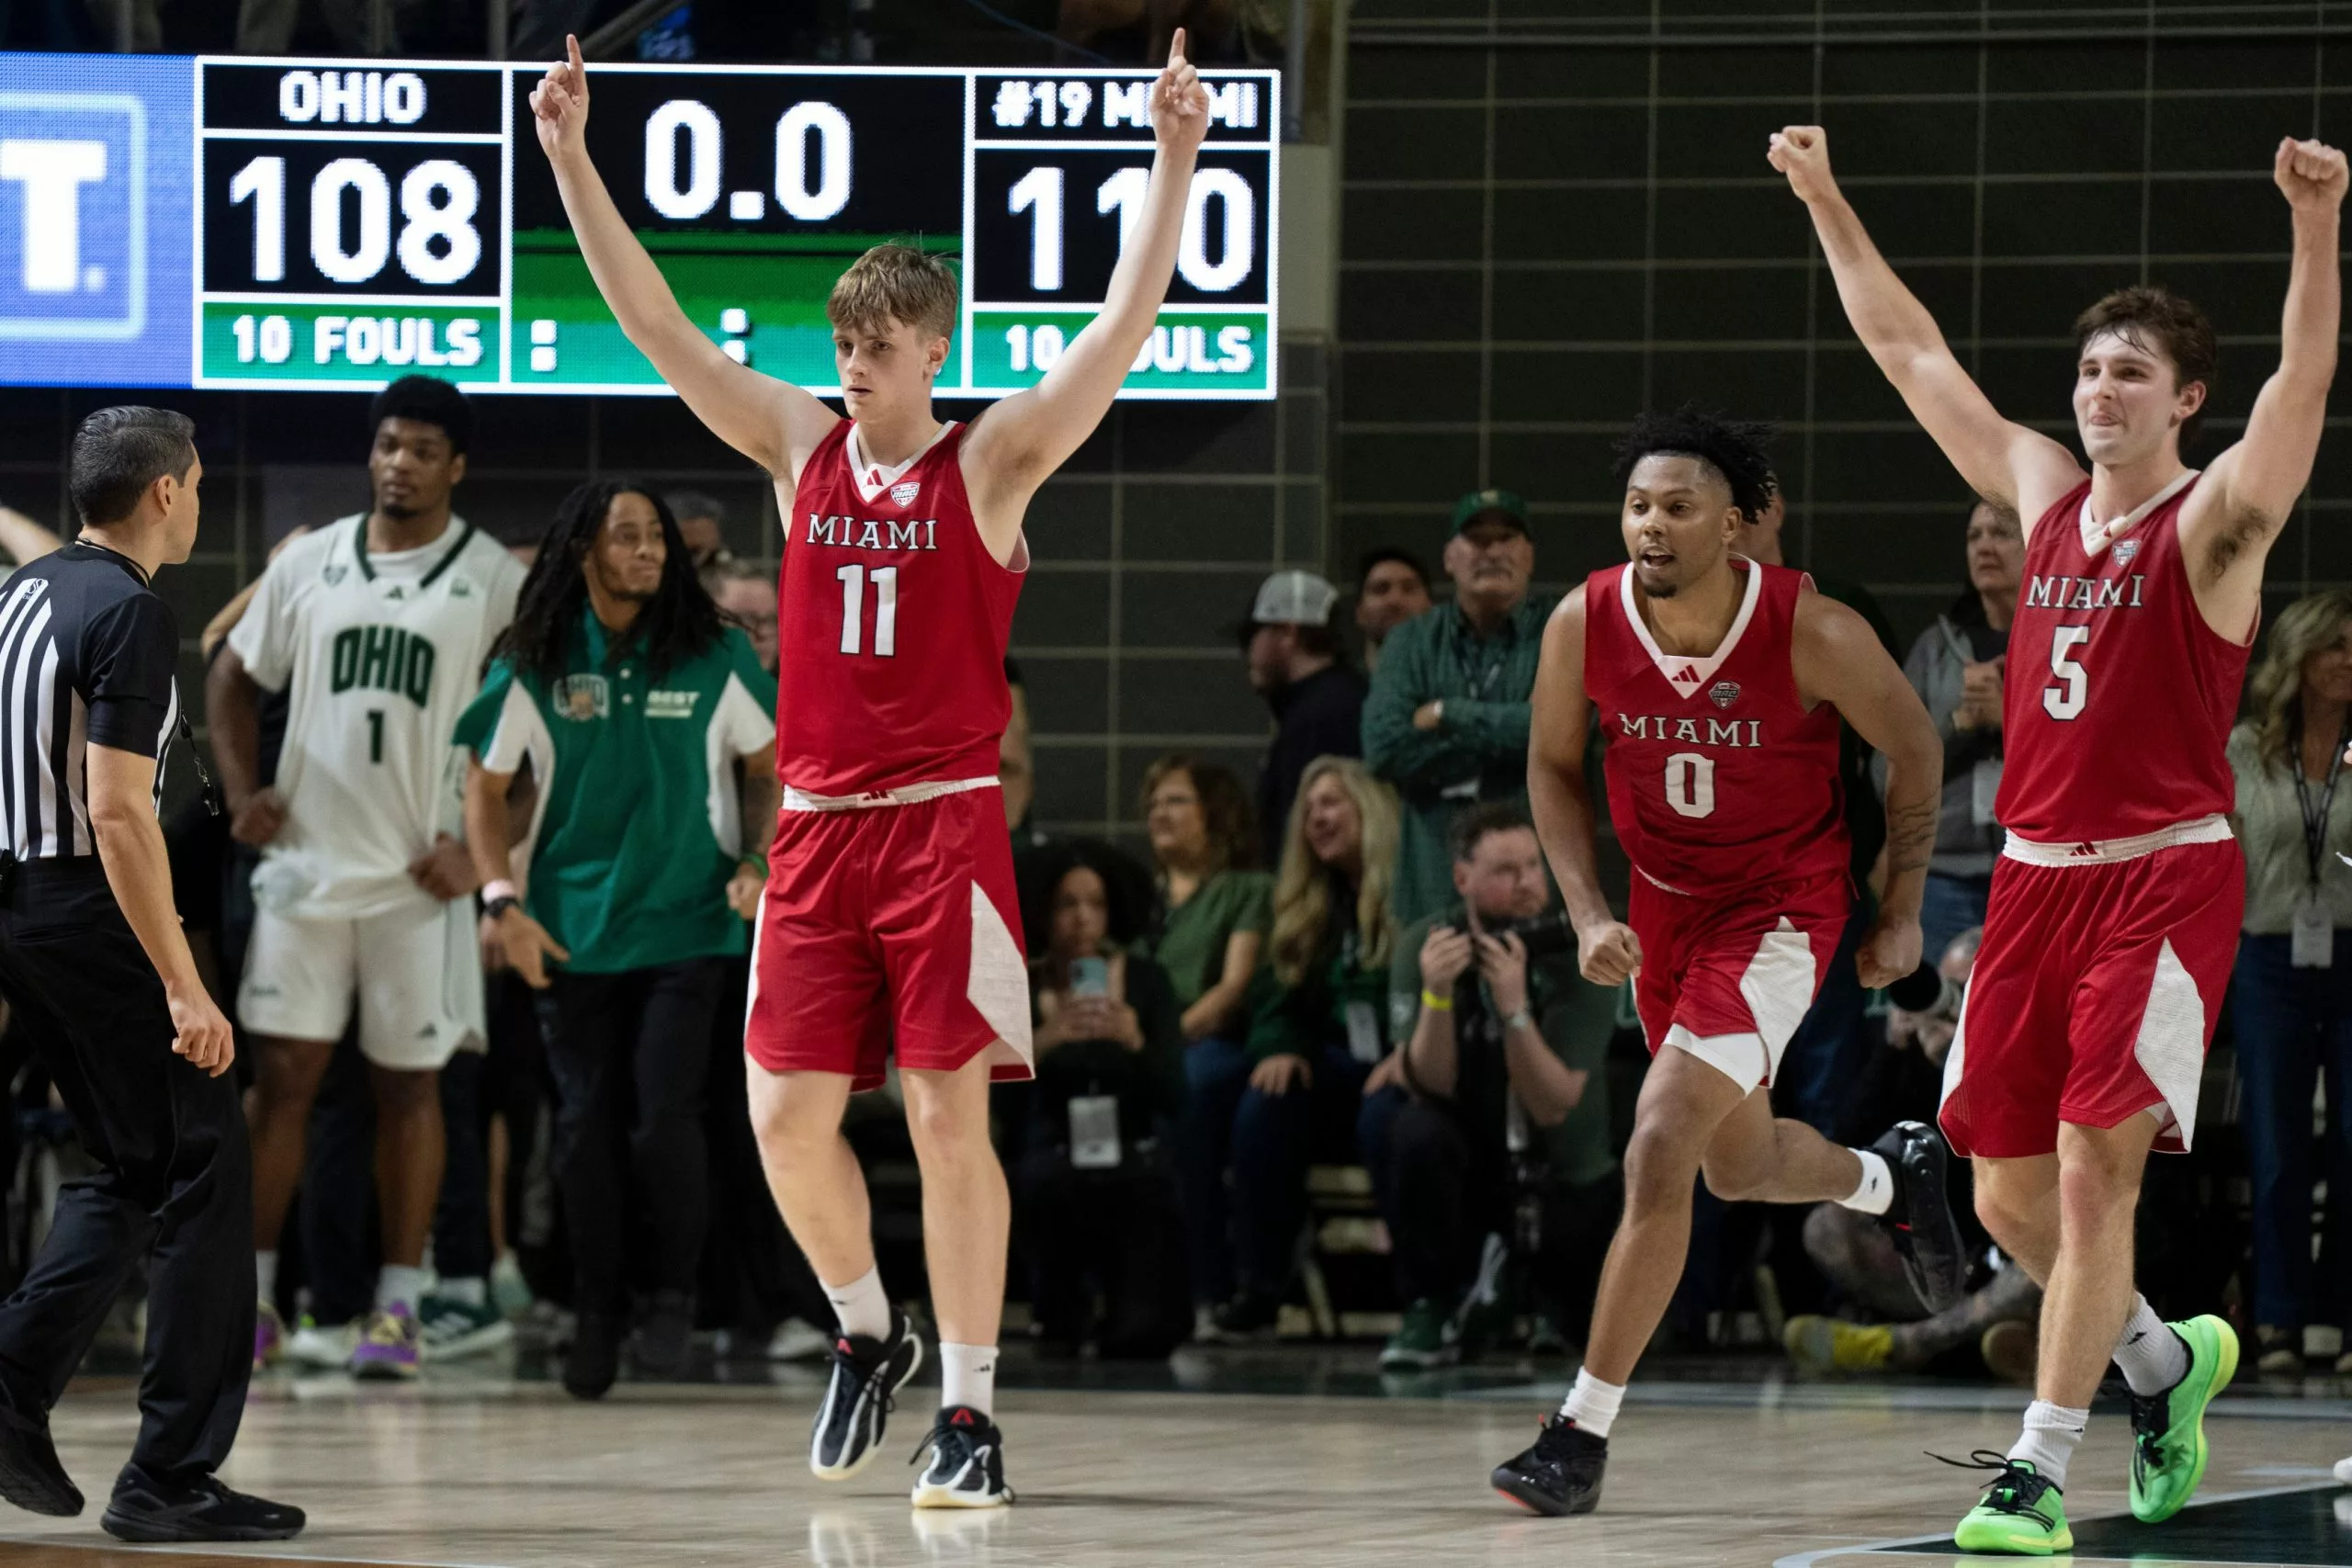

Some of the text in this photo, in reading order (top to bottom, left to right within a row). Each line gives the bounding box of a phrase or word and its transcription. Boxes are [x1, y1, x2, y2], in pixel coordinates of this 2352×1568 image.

[279, 71, 426, 123] OHIO
[992, 81, 1259, 128] #19 MMI
[644, 99, 854, 220] 0.0
[230, 156, 481, 284] 108
[1008, 167, 1256, 291] 110
[233, 315, 482, 367] 10 FOULS
[1006, 324, 1064, 371] 10
[806, 513, 939, 550] MIAMI
[836, 563, 898, 658] 11
[2025, 574, 2145, 610] MIAMI
[332, 626, 435, 709] OHIO
[2042, 625, 2090, 721] 5
[368, 710, 384, 763] 1
[1617, 713, 1762, 748] MIAMI
[1665, 752, 1715, 819] 0
